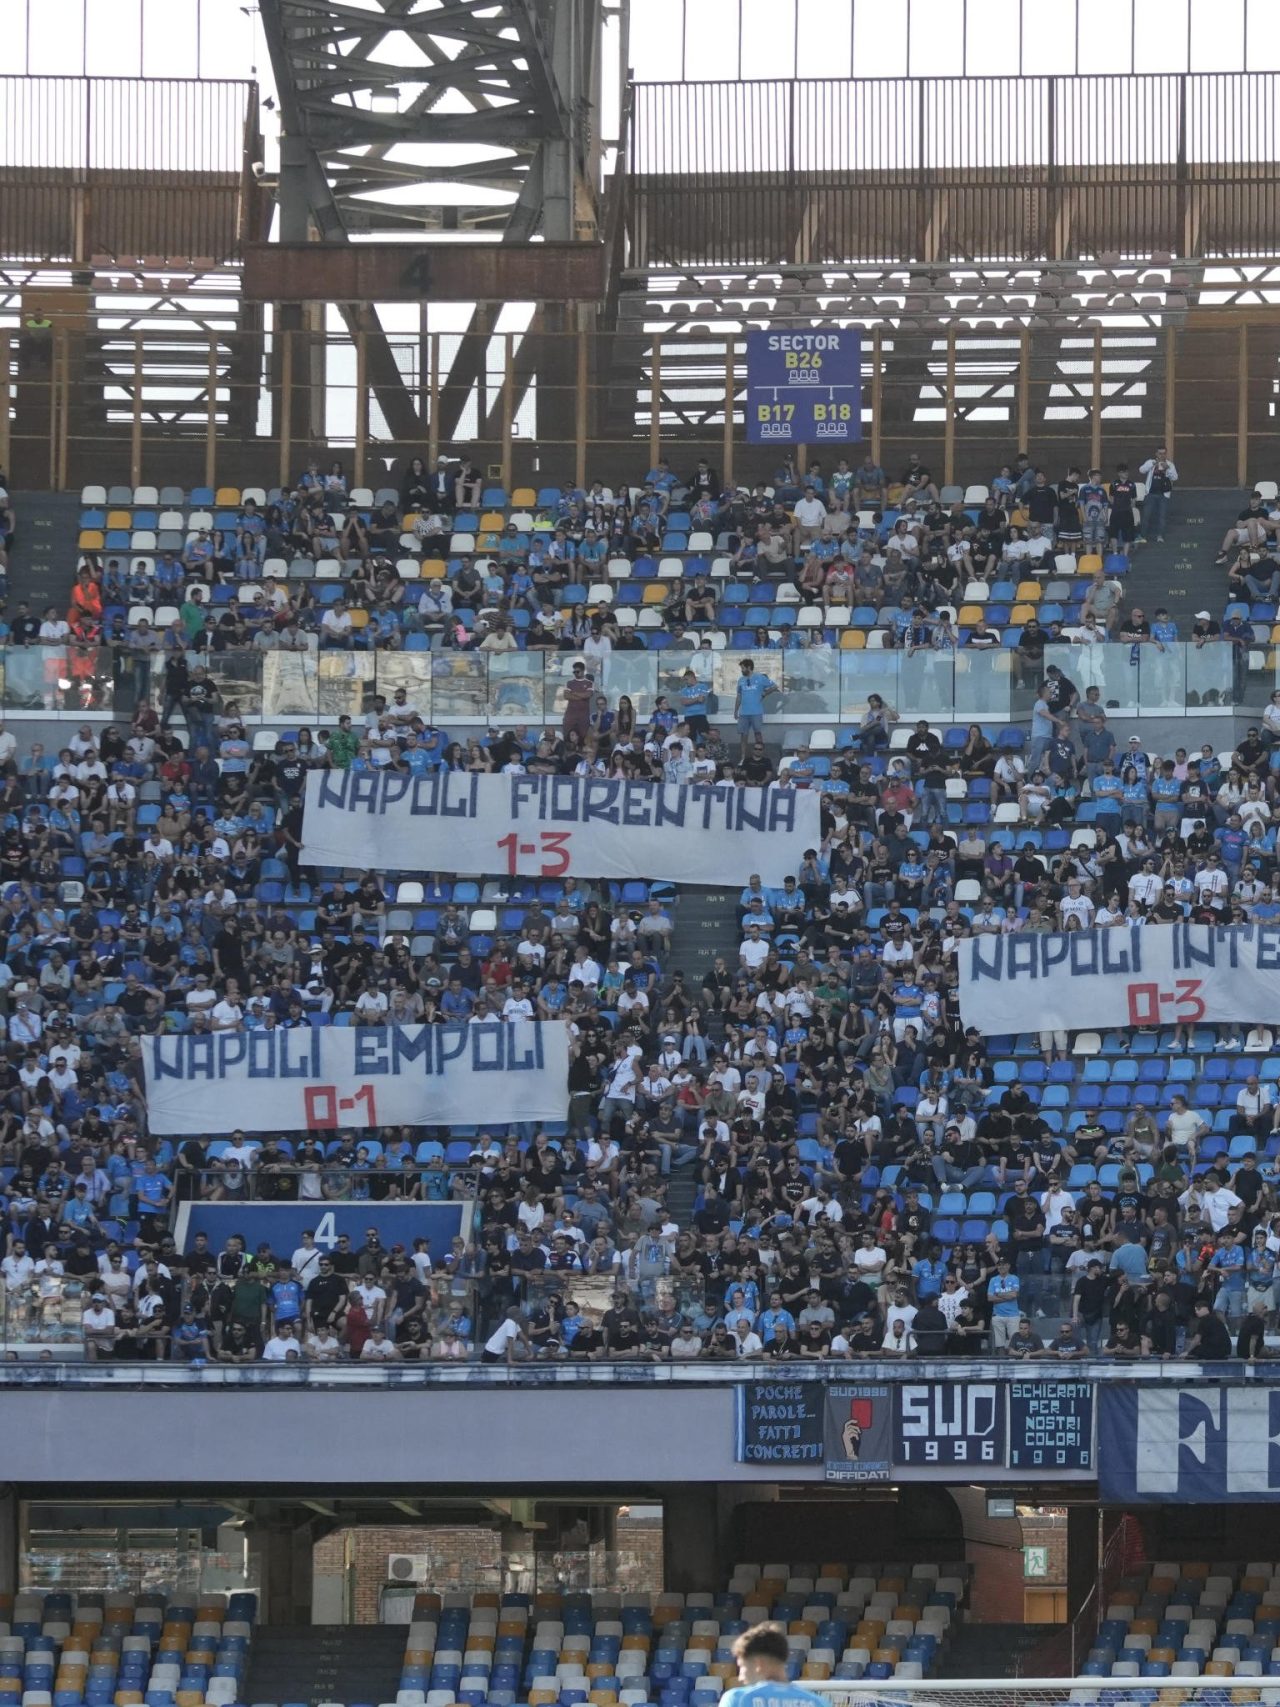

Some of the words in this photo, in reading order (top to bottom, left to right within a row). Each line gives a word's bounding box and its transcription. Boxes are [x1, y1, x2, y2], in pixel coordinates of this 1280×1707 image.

[400, 252, 432, 294] 4
[768, 335, 839, 350] SECTOR
[785, 352, 822, 368] B26
[758, 405, 795, 421] B17
[814, 404, 850, 421] B18
[318, 769, 478, 819] NAPOLI
[510, 773, 796, 833] FIORENTINA
[496, 831, 572, 878] 1-3
[970, 924, 1142, 981] NAPOLI
[1127, 979, 1207, 1026] 0-3
[153, 1026, 321, 1082] NAPOLI
[354, 1020, 544, 1076] EMPOLI
[303, 1084, 377, 1130] 0-1
[313, 1211, 340, 1250] 4
[755, 1385, 803, 1401] POCHE
[829, 1386, 888, 1397] SUD1996
[1012, 1384, 1091, 1398] SCHIERATI
[902, 1384, 996, 1437] SUD
[1029, 1400, 1060, 1414] PER
[1070, 1400, 1075, 1414] I
[1025, 1416, 1081, 1430] NOSTRI
[1025, 1432, 1081, 1446] COLORI
[902, 1440, 995, 1462] 1996
[1012, 1449, 1089, 1465] 1996
[826, 1470, 890, 1480] DIFFIDATI
